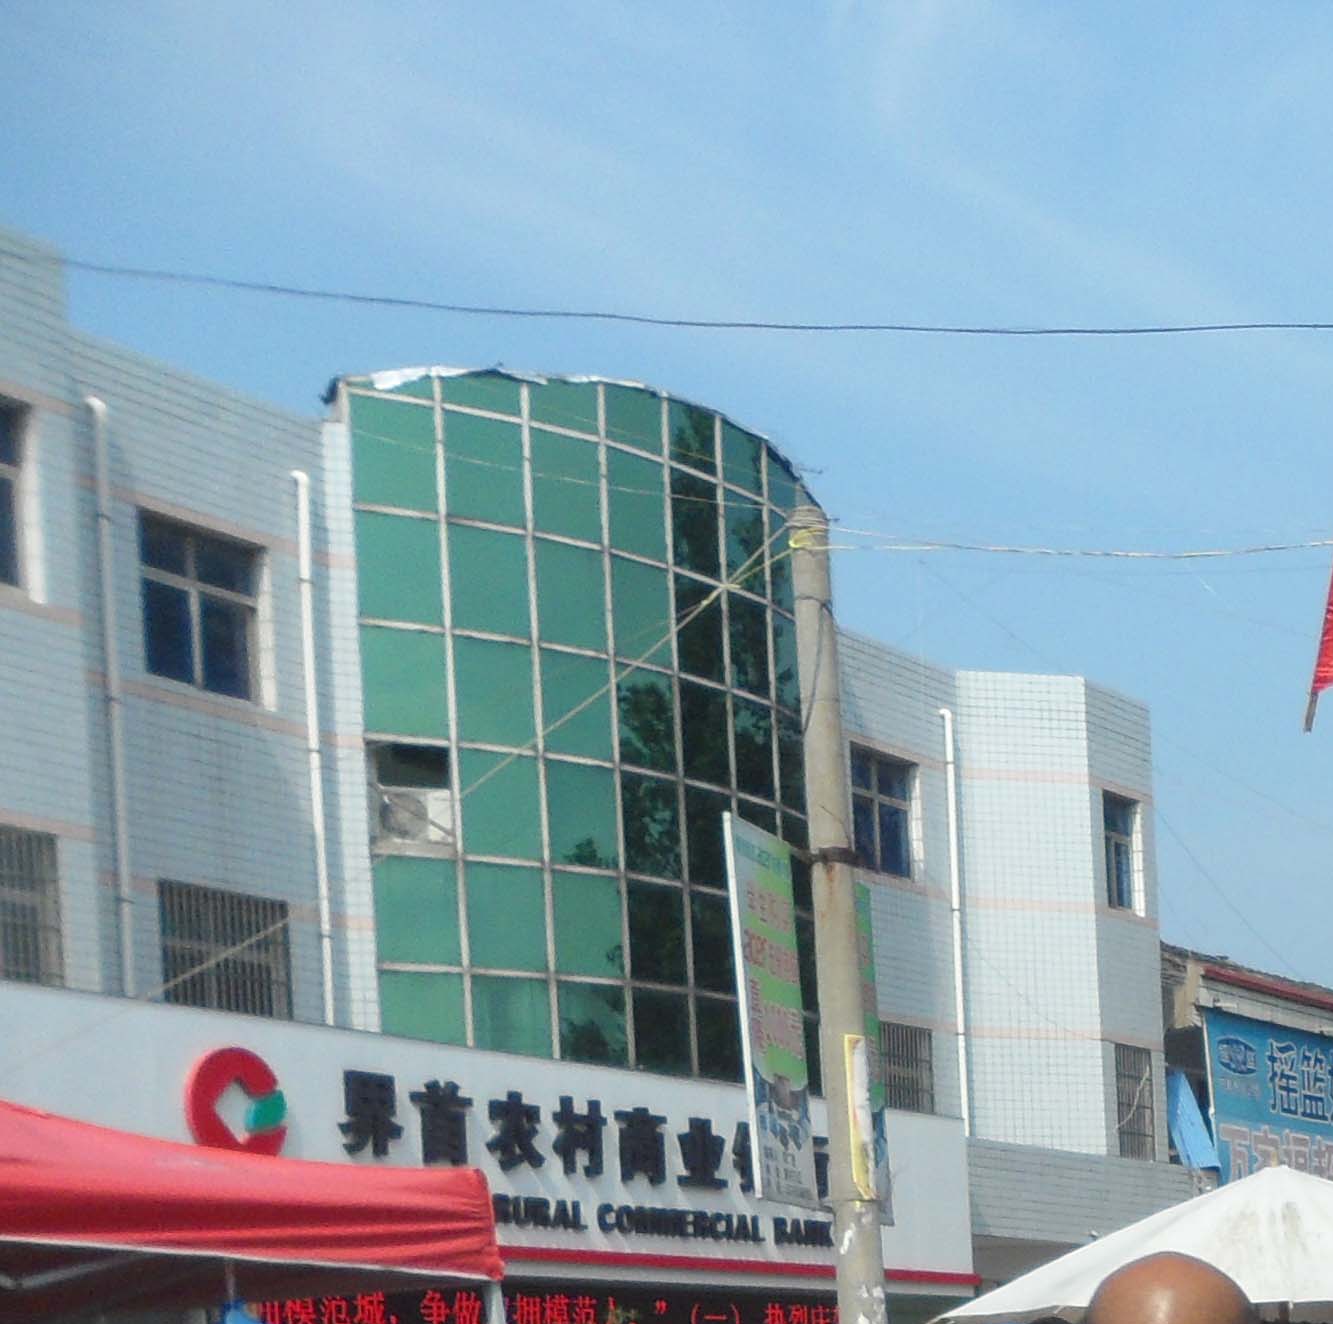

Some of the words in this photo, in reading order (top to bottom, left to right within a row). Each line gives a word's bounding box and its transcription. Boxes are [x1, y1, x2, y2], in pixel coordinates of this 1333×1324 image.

[337, 1069, 829, 1200] 界首农村商业
[598, 1202, 766, 1242] COMMERCIAL
[774, 1216, 834, 1247] BANK
